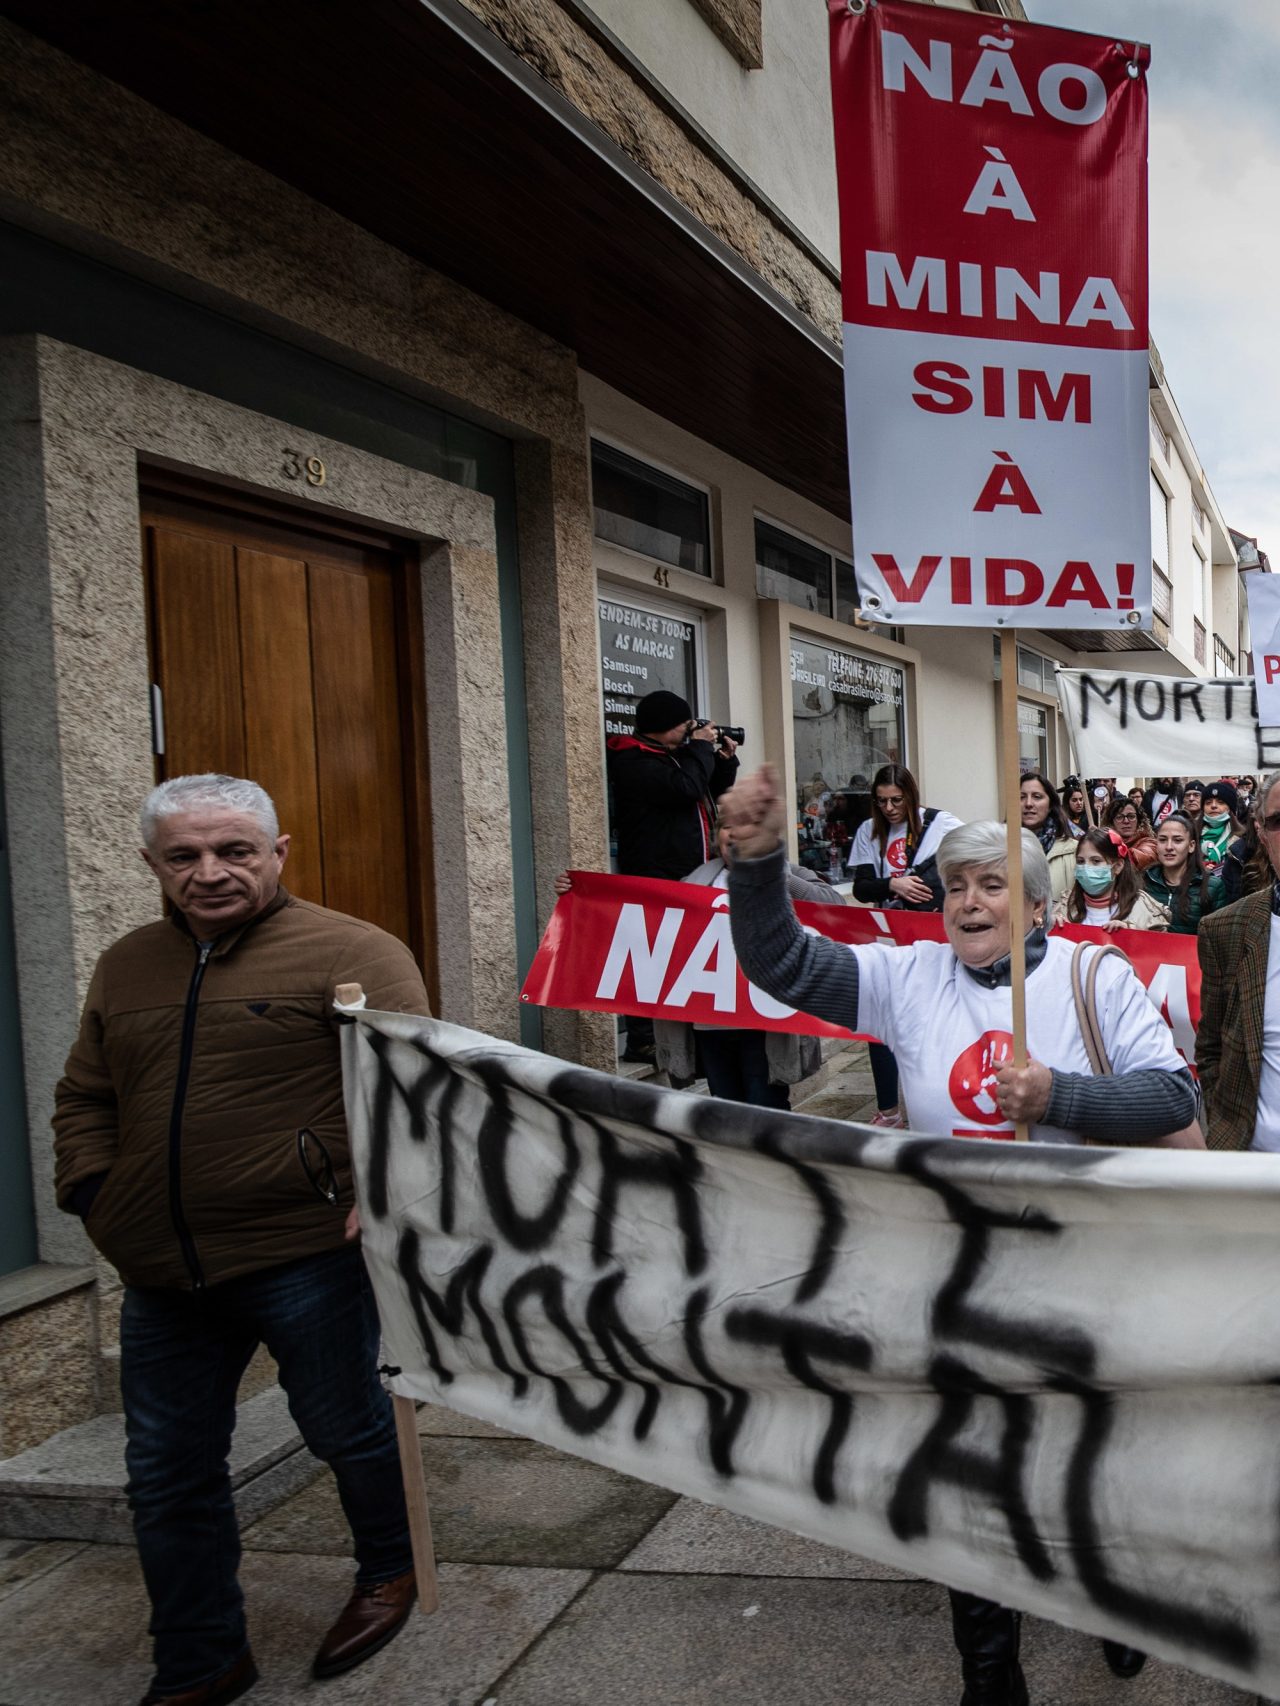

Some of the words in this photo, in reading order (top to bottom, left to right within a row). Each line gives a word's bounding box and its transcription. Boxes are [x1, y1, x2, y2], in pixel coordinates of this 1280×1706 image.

[881, 29, 1107, 126] NÃO
[963, 146, 1036, 222] À
[865, 250, 1134, 331] MINA
[912, 361, 1092, 424] SIM
[281, 447, 326, 487] 39
[972, 450, 1042, 515] À
[653, 567, 669, 588] 41
[871, 553, 1135, 610] VIDA!
[599, 604, 658, 633] ENDEM-SE
[661, 620, 691, 642] TODAS
[615, 633, 630, 650] AS
[632, 637, 675, 660] MARCAS
[602, 656, 648, 680] Samsung
[604, 677, 634, 695] Bosch
[605, 699, 637, 715] Simen
